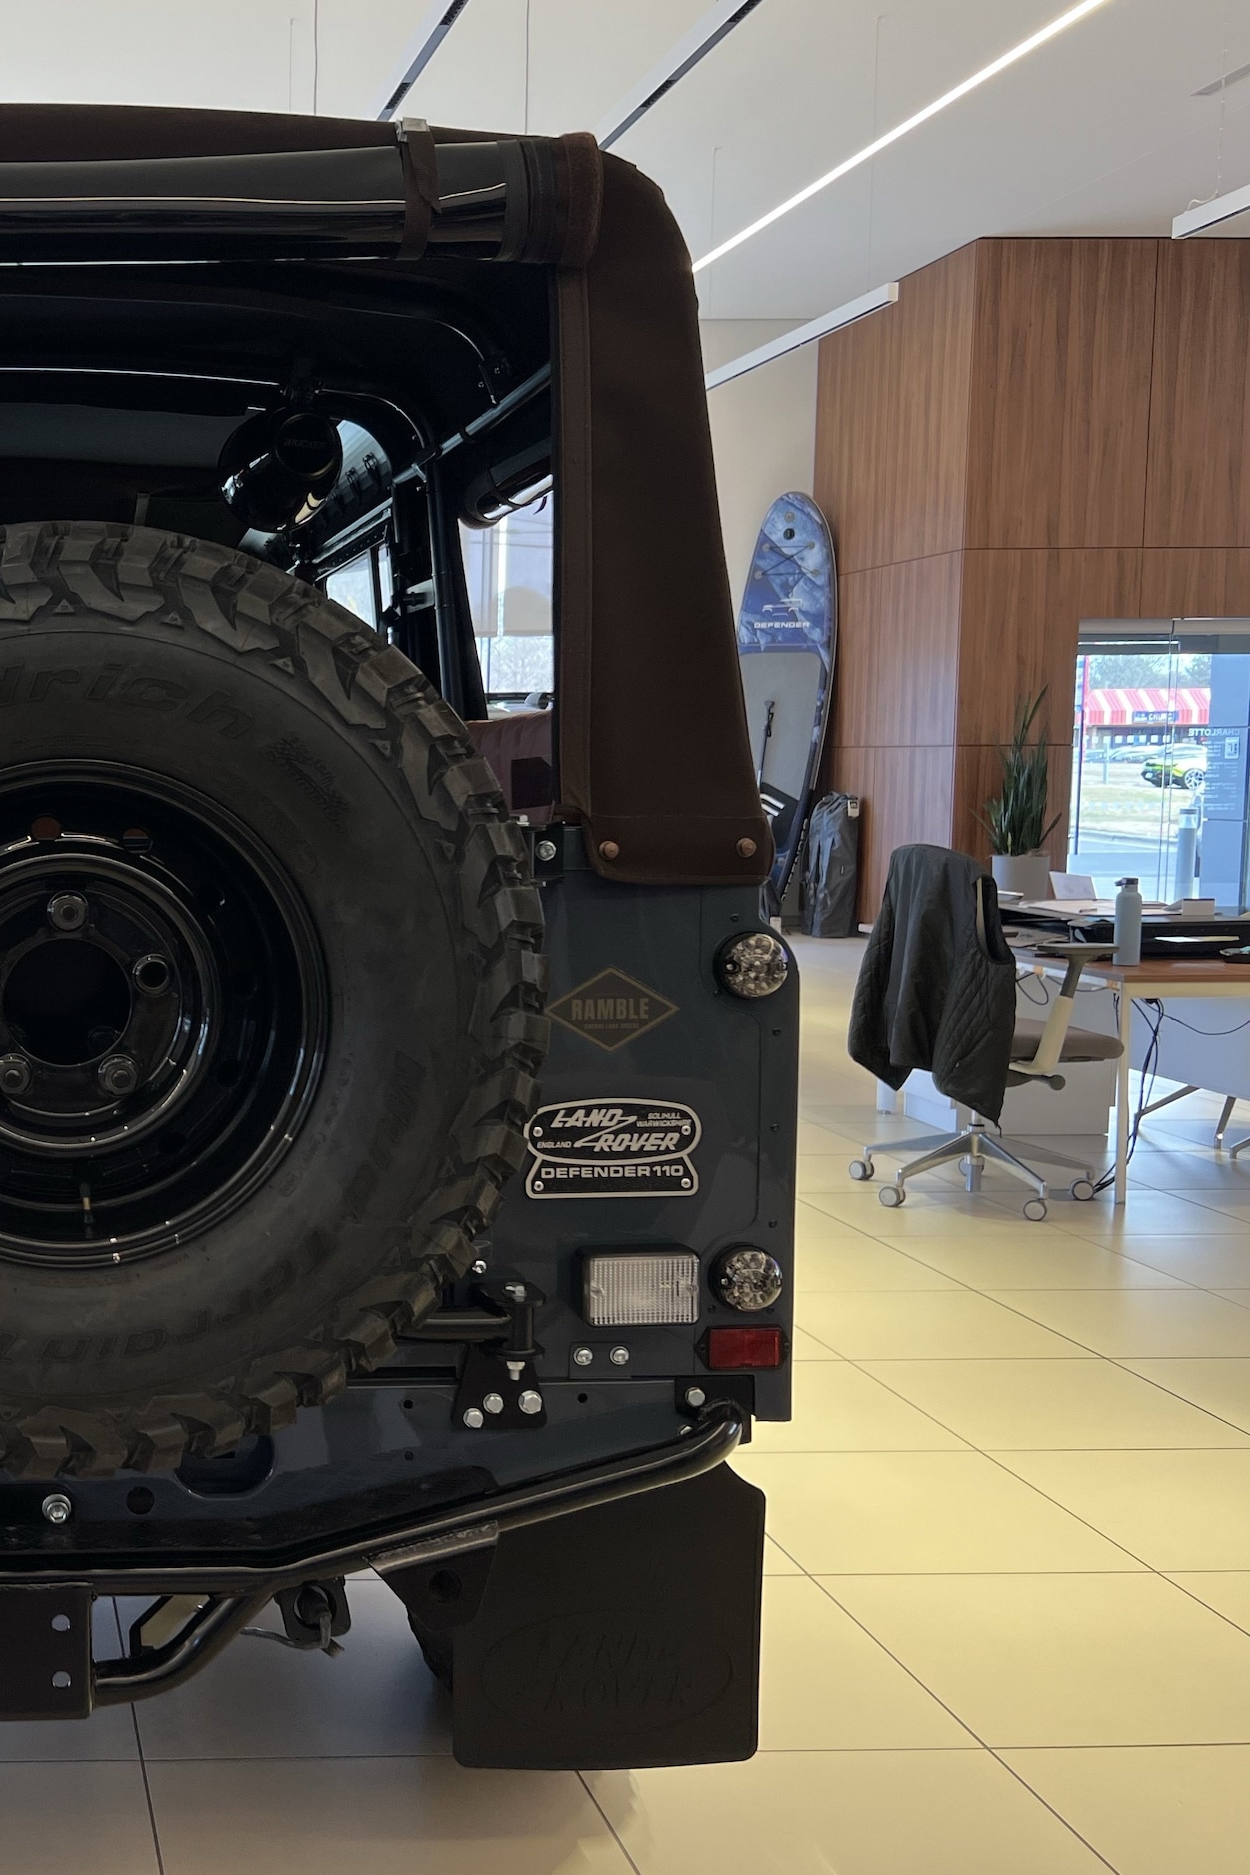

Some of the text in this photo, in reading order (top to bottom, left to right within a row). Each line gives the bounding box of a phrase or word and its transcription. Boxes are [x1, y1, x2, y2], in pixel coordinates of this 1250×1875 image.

[753, 621, 810, 629] DEFENDER
[570, 997, 650, 1021] RAMBLE
[550, 1108, 626, 1129] LAND
[647, 1112, 682, 1120] SOLIHULL
[536, 1140, 572, 1149] ENGLAND
[592, 1131, 681, 1152] ROVER
[540, 1164, 684, 1179] DEFENDER 110
